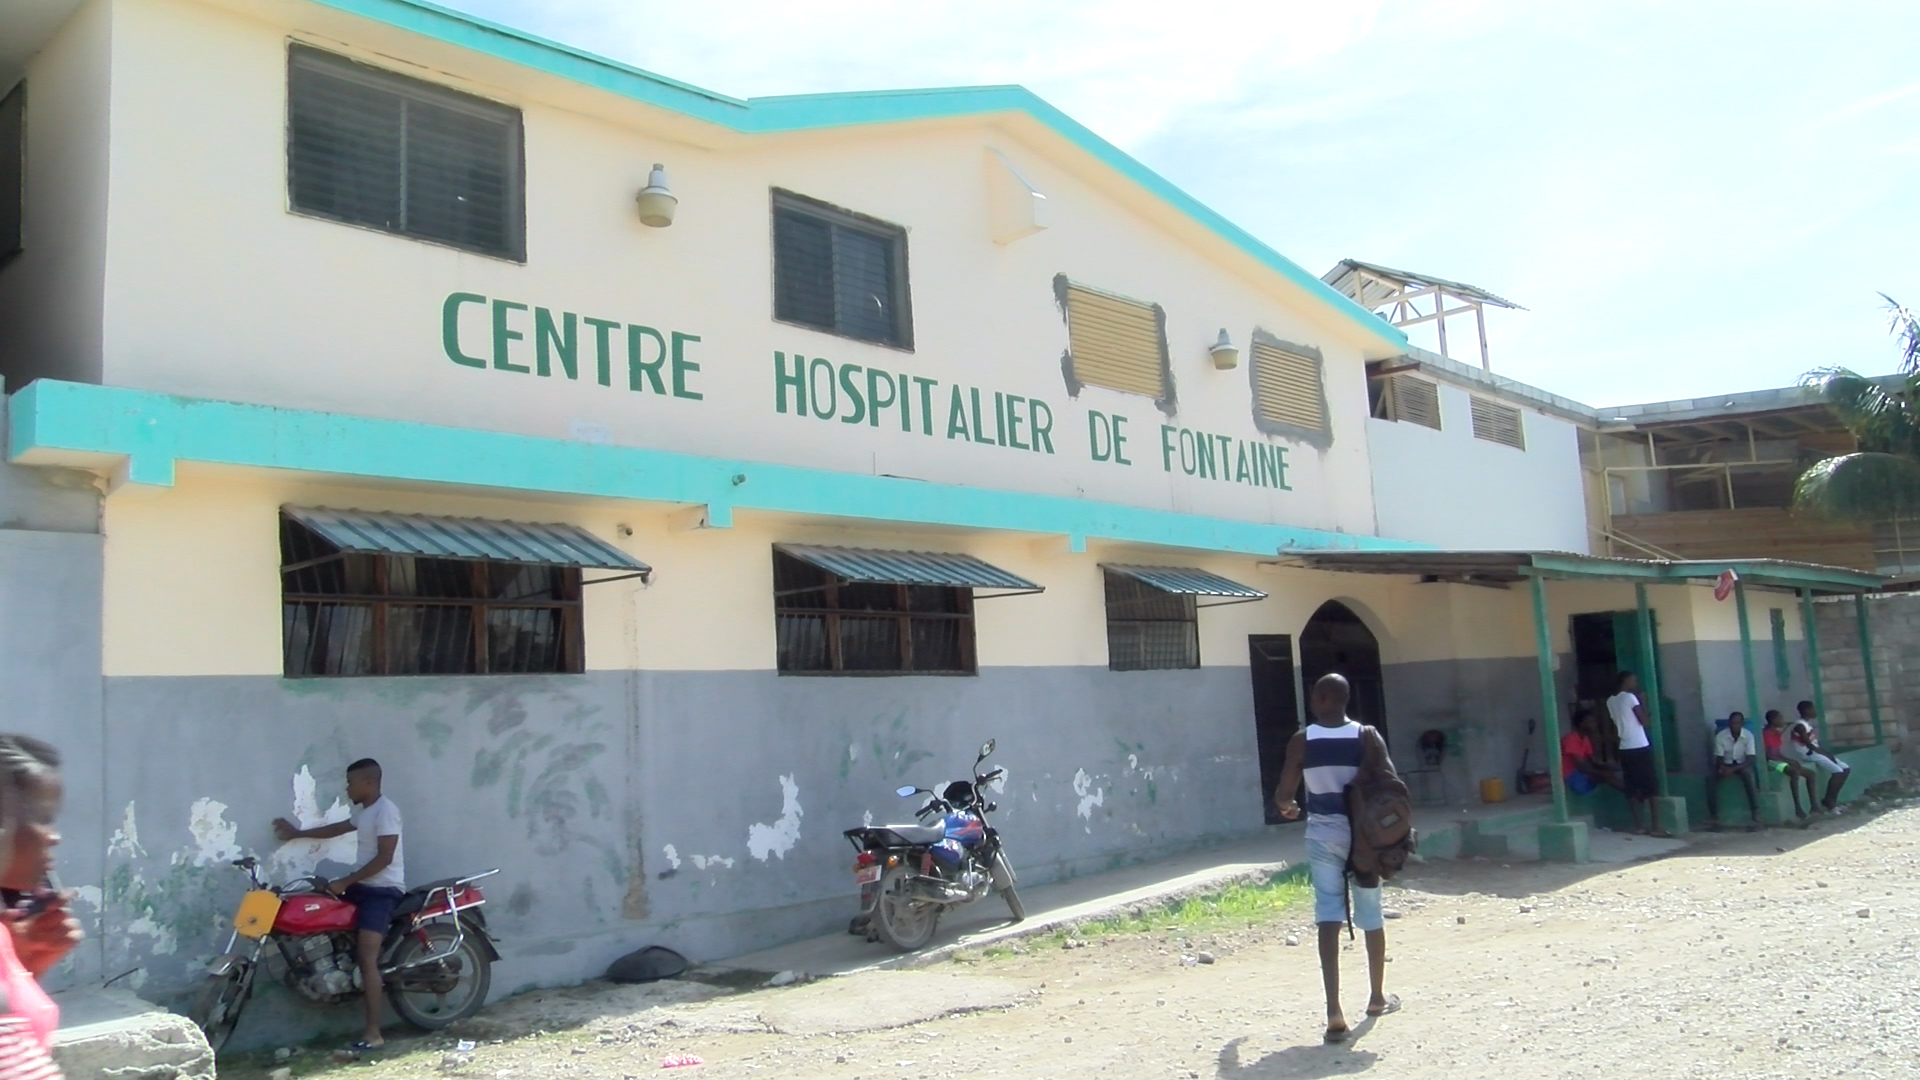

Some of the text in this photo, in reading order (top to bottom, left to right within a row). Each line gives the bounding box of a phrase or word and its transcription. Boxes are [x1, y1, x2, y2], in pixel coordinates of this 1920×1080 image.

[442, 292, 1293, 491] CENTRE HOSPITALIER DE FONTAINE
